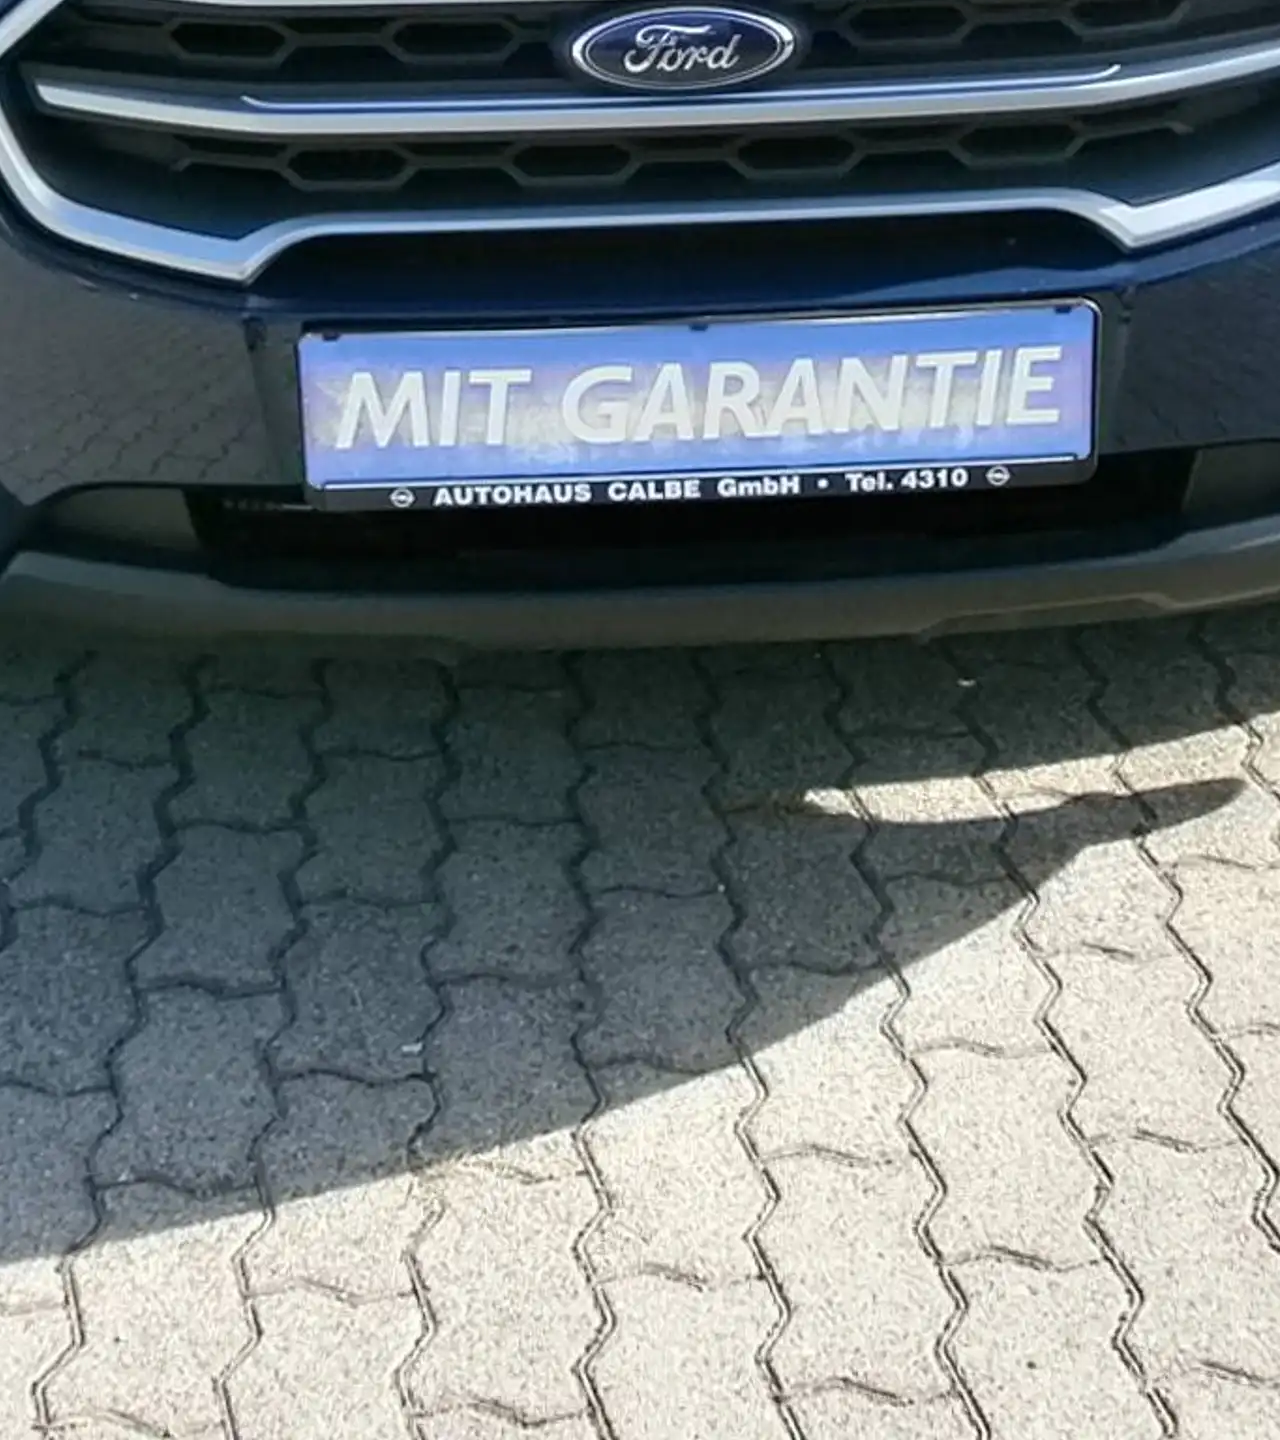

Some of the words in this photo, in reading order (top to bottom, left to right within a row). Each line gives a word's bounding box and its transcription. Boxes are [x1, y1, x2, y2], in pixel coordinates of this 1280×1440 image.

[623, 24, 742, 73] Ford
[335, 369, 532, 450] MIT
[562, 345, 1063, 446] GARANTIE
[433, 482, 593, 506] AUTOHAUS
[608, 479, 701, 502] CALBE
[717, 475, 800, 498] GmbH
[844, 471, 893, 493] Tel.
[900, 468, 969, 490] 4310
